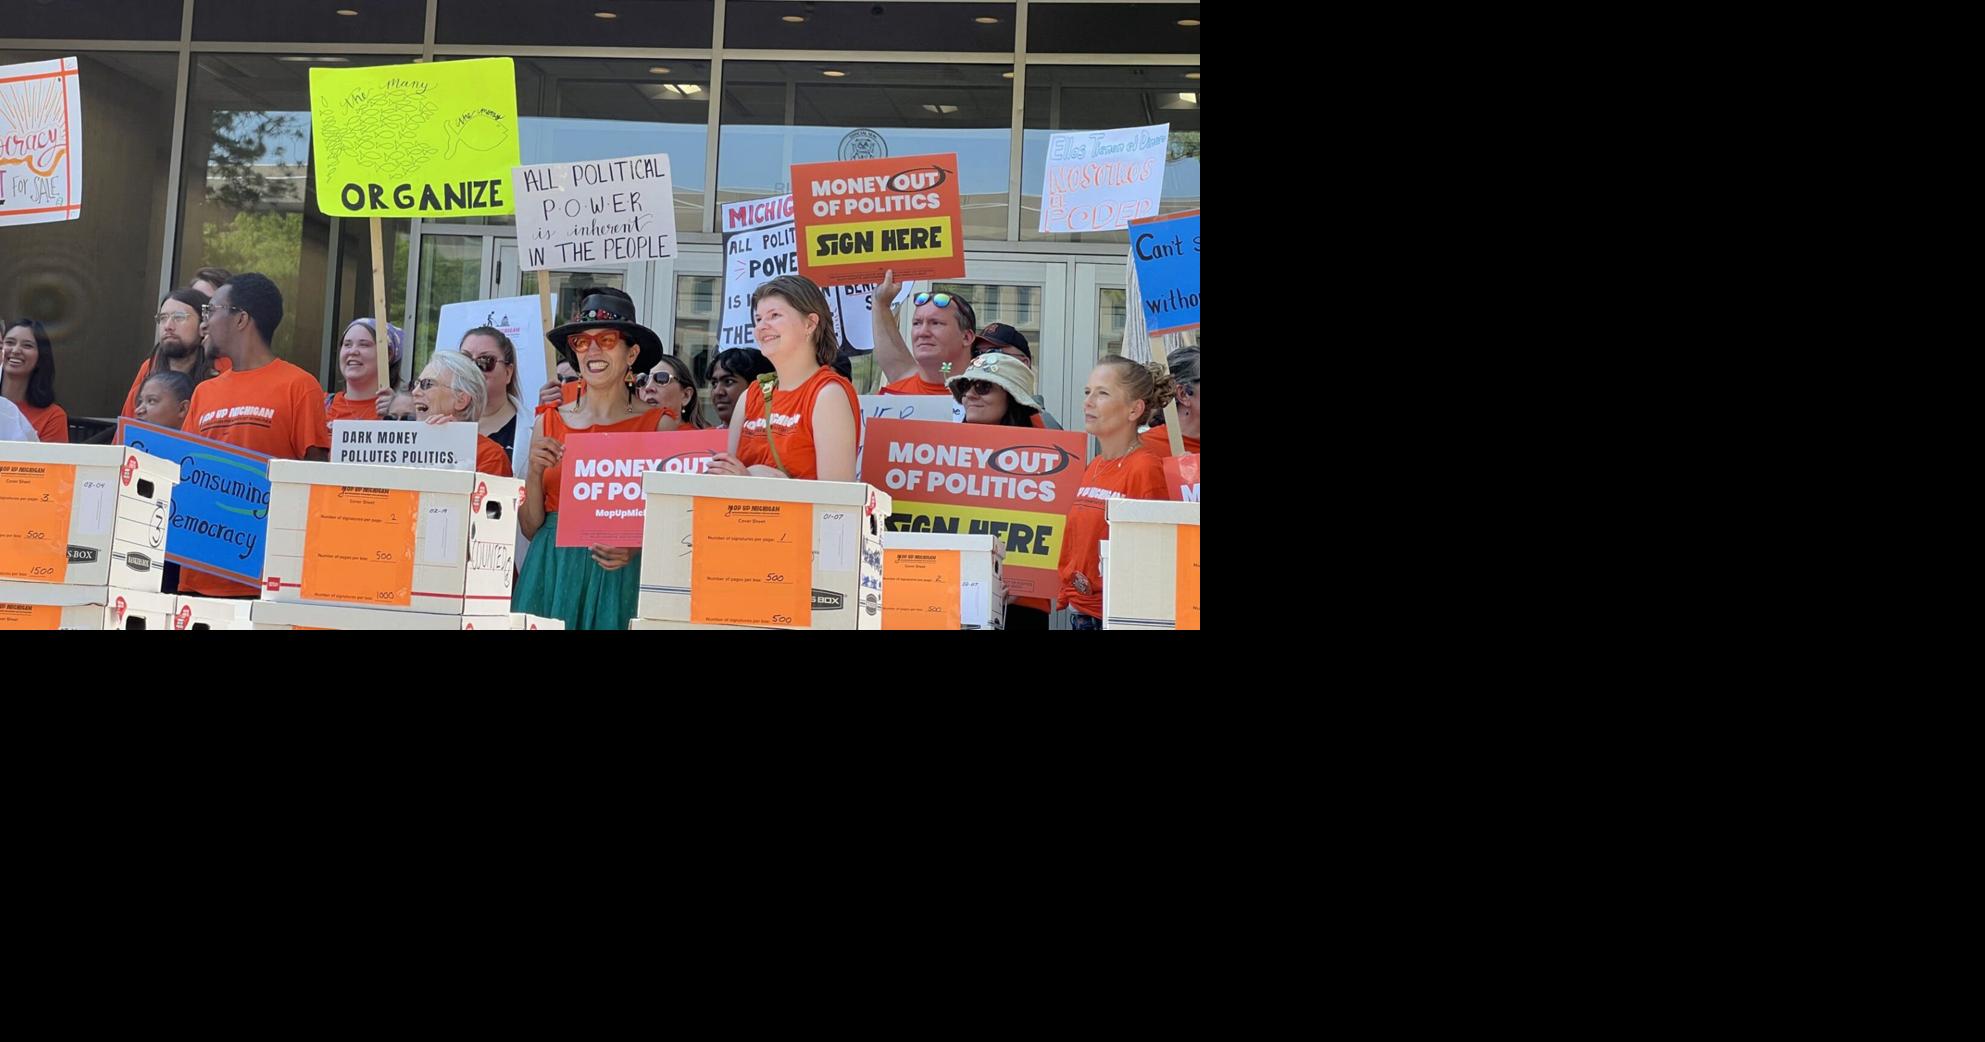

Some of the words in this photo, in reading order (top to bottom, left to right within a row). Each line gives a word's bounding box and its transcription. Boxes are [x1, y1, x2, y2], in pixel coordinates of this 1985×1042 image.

[524, 168, 559, 193] ALL
[572, 158, 665, 187] POLITICAL
[811, 175, 890, 197] MONEY
[892, 172, 939, 191] OUT
[341, 179, 504, 212] ORGANIZE
[812, 200, 841, 217] OF
[845, 193, 941, 216] POLITICS
[532, 227, 556, 241] is
[567, 213, 654, 237] inherent
[528, 247, 545, 267] IN
[554, 241, 596, 264] THE
[604, 234, 671, 260] PEOPLE
[728, 238, 753, 256] ALL
[816, 230, 874, 257] SIGN
[881, 226, 942, 252] HERE
[1136, 233, 1183, 261] Can't
[728, 295, 742, 309] IS
[1146, 287, 1200, 315] witho
[722, 324, 755, 345] THE
[342, 431, 372, 444] DARK
[377, 431, 418, 444] MONEY
[341, 450, 397, 463] POLLUTES
[402, 451, 458, 464] POLITICS.
[575, 457, 662, 478] MONEY
[888, 441, 993, 470] MONEY
[997, 449, 1059, 473] OUT
[180, 456, 270, 520] Consuming
[573, 482, 604, 501] OF
[885, 468, 923, 491] OF
[927, 471, 1056, 502] POLITICS
[595, 508, 646, 519] MopUpMic
[969, 520, 1053, 556] HERE
[73, 550, 93, 559] BOX
[375, 550, 392, 561] 500
[766, 573, 784, 582] 500
[376, 591, 395, 600] 1000
[817, 596, 840, 605] BOX
[771, 614, 792, 625] 500
